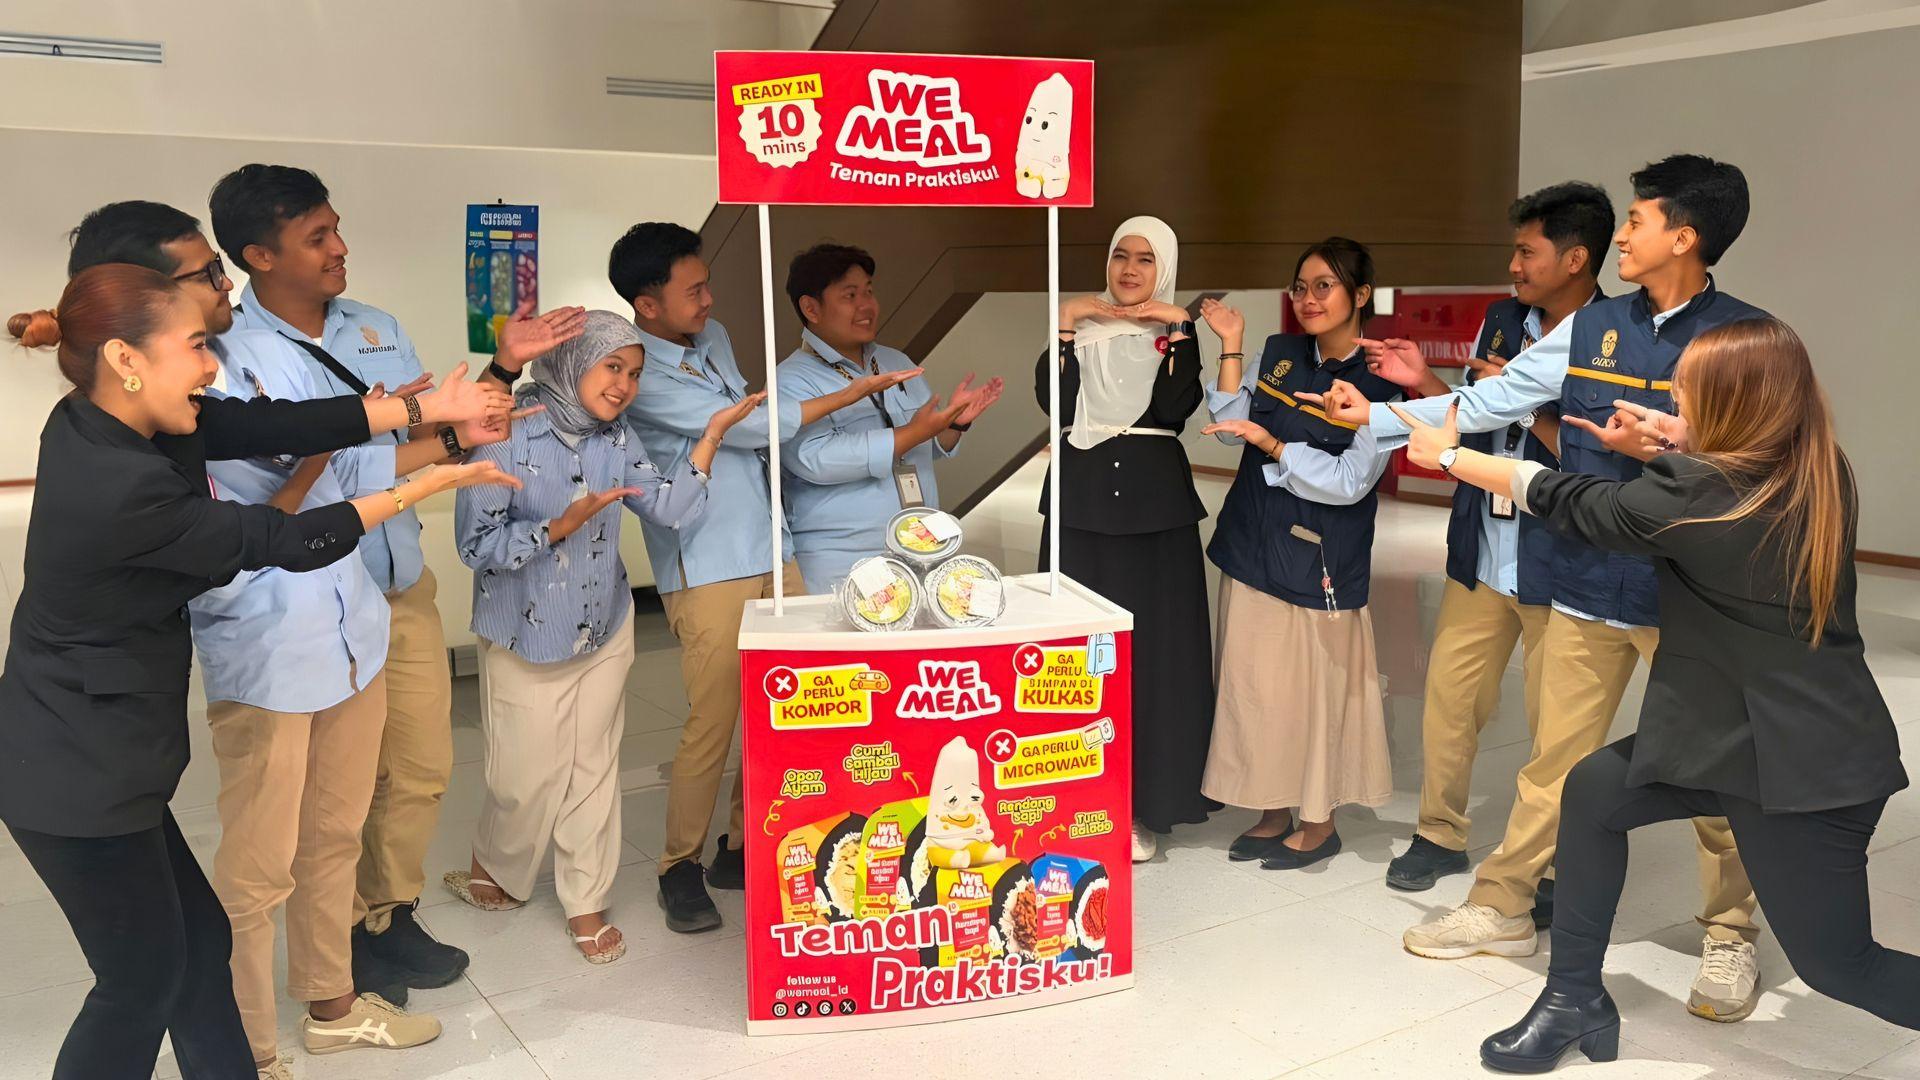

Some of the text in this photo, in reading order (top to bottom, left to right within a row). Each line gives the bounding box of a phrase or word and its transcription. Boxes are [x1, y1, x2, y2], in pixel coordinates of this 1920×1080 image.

[740, 80, 817, 101] READY IN
[876, 77, 955, 121] WE
[757, 103, 805, 139] 10
[844, 114, 983, 158] MEAL
[763, 140, 806, 155] mins
[829, 162, 1000, 188] Teman Praktisku!
[1057, 654, 1074, 664] GA
[923, 665, 976, 690] WE
[1047, 665, 1082, 676] PERLU
[813, 675, 834, 687] GA
[1028, 678, 1093, 689] SIMPAN DI
[803, 686, 845, 700] PERLU
[1022, 689, 1094, 705] KULKAS
[782, 700, 862, 719] KOMPOR
[901, 688, 997, 715] MEAL
[1021, 739, 1079, 758] GA PERLU
[1003, 753, 1098, 779] MICROWAVE
[786, 770, 822, 783] Opor
[782, 781, 825, 797] Ayam
[1076, 812, 1106, 824] Tuna
[877, 822, 899, 836] WE
[1070, 821, 1112, 837] Balado
[868, 833, 906, 848] MEAL
[959, 871, 984, 887] WE
[1048, 869, 1068, 883] WE
[950, 884, 992, 899] MEAL
[1038, 879, 1073, 895] MEAL
[774, 907, 951, 955] Teman
[786, 975, 837, 986] follow us
[872, 955, 1111, 1008] Praktisku!
